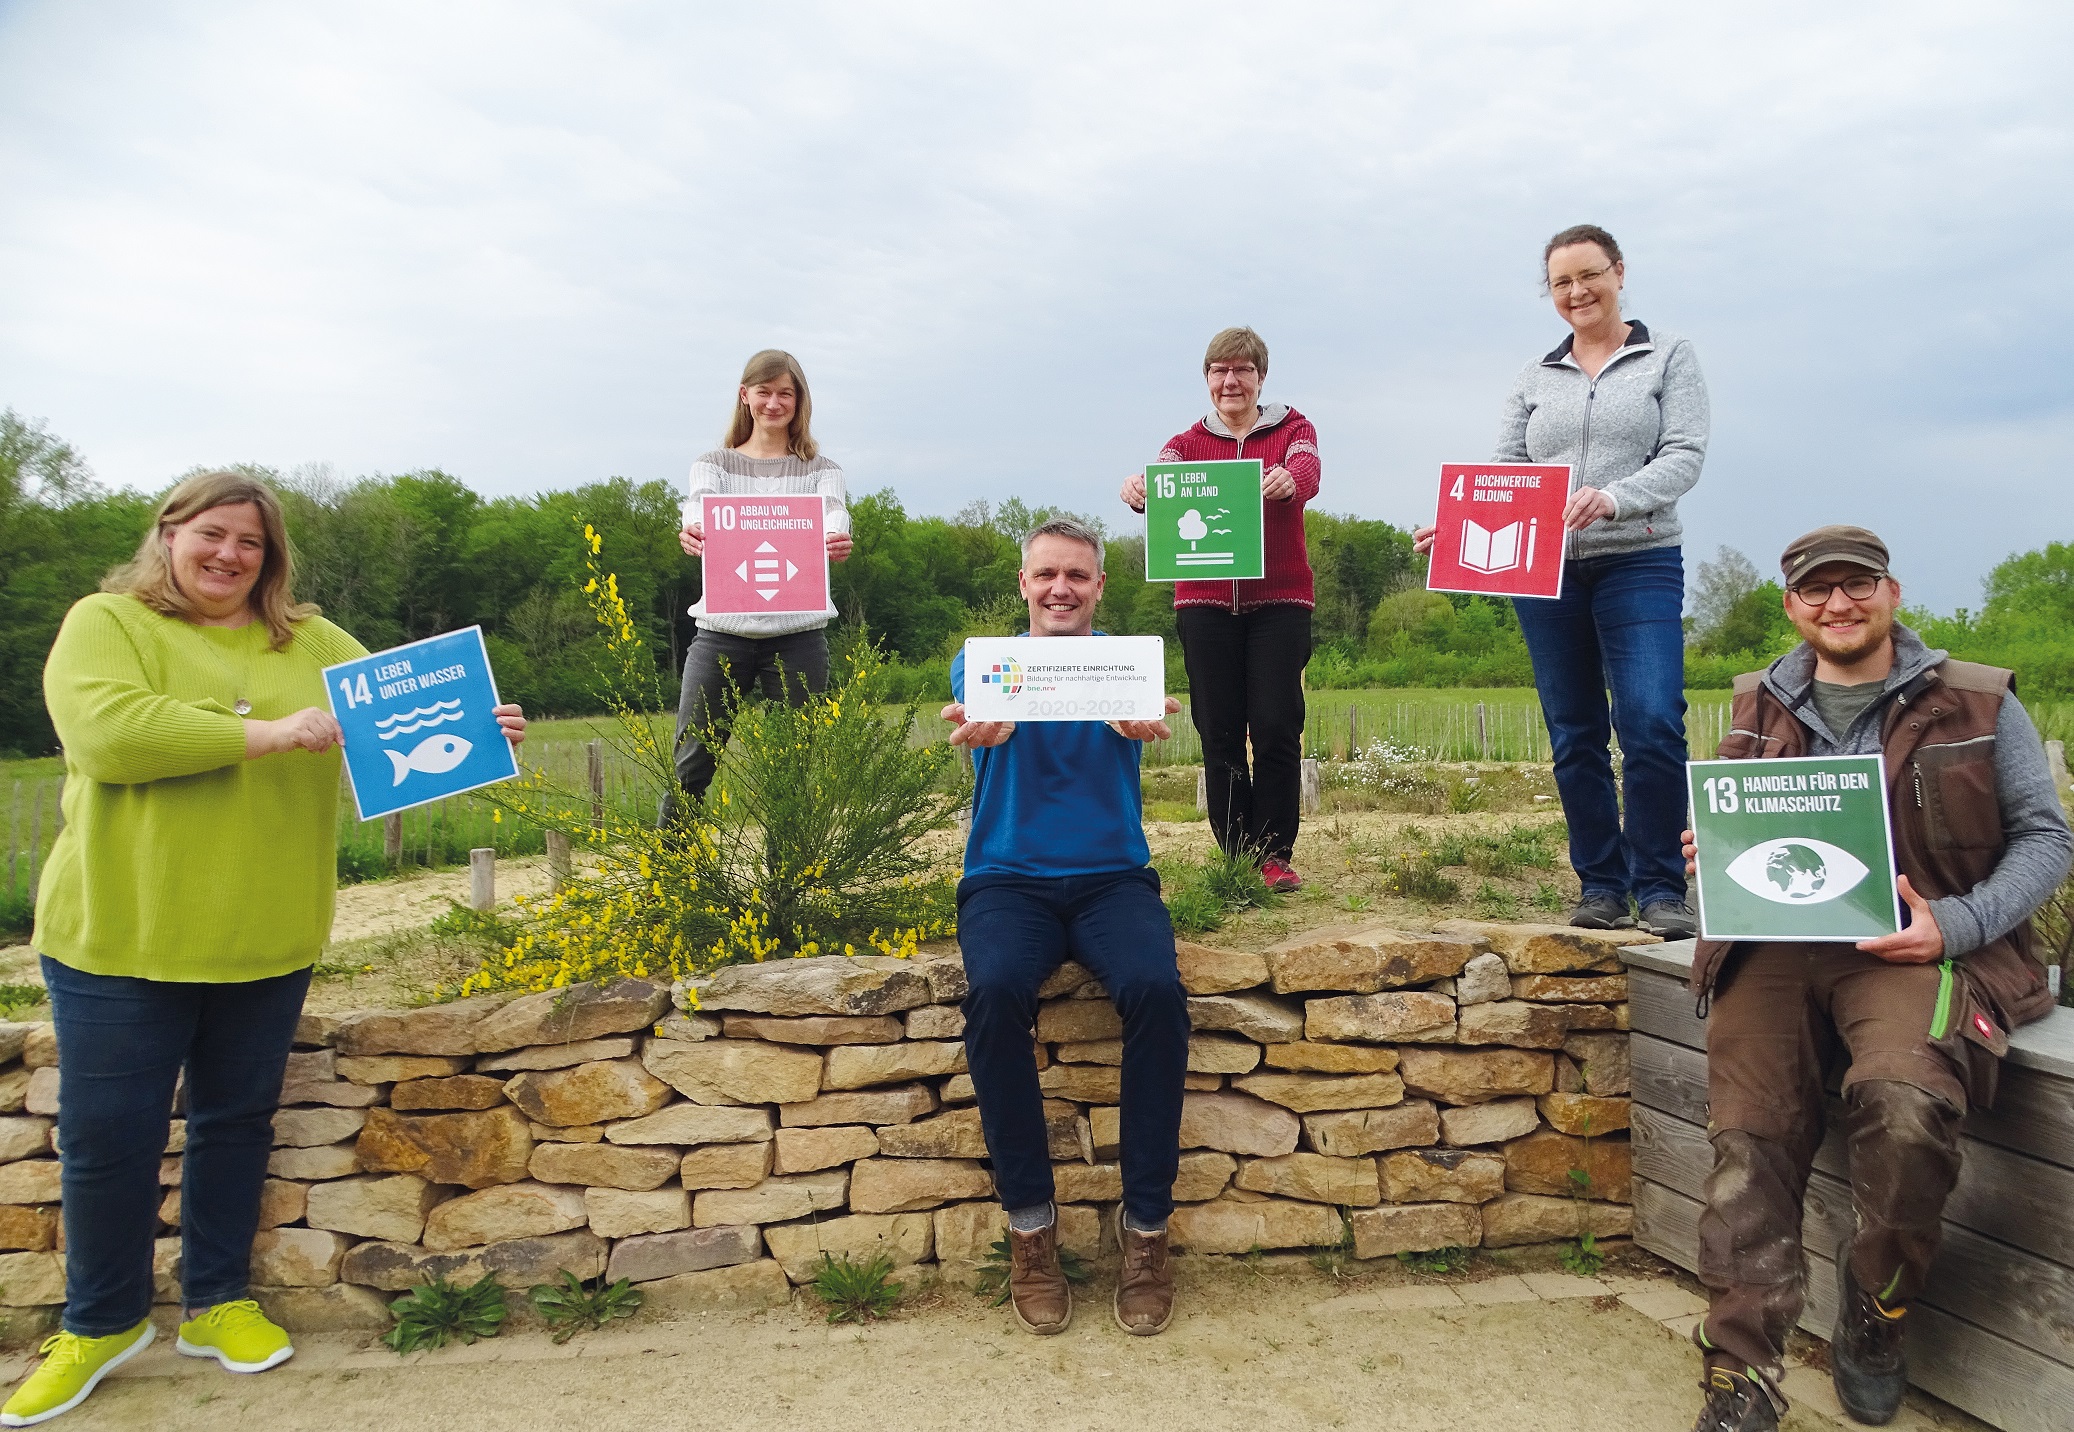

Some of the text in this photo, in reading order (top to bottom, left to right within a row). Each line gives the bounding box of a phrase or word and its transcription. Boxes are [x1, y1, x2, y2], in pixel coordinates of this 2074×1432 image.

[1154, 473, 1176, 499] 15
[1180, 472, 1207, 484] LEBEN
[1474, 474, 1542, 488] HOCHWERTIGE
[1180, 485, 1219, 498] AN LAND
[1449, 474, 1465, 502] 4
[1472, 489, 1514, 502] BILDUNG
[711, 505, 736, 531] 10
[740, 505, 789, 516] ABBAU VON
[740, 518, 813, 530] UNGLEICHHEITEN
[374, 659, 413, 682] LEBEN
[1026, 674, 1147, 683] Bildung für nachhaltige Entwicklung
[339, 672, 373, 709] 14
[379, 663, 467, 700] UNTER WASSER
[1027, 699, 1136, 717] 2020-2023
[1743, 771, 1870, 793] HANDELN FÜR DEN
[1703, 777, 1739, 813] 13
[1744, 795, 1842, 814] KLIMASCHUTZ
